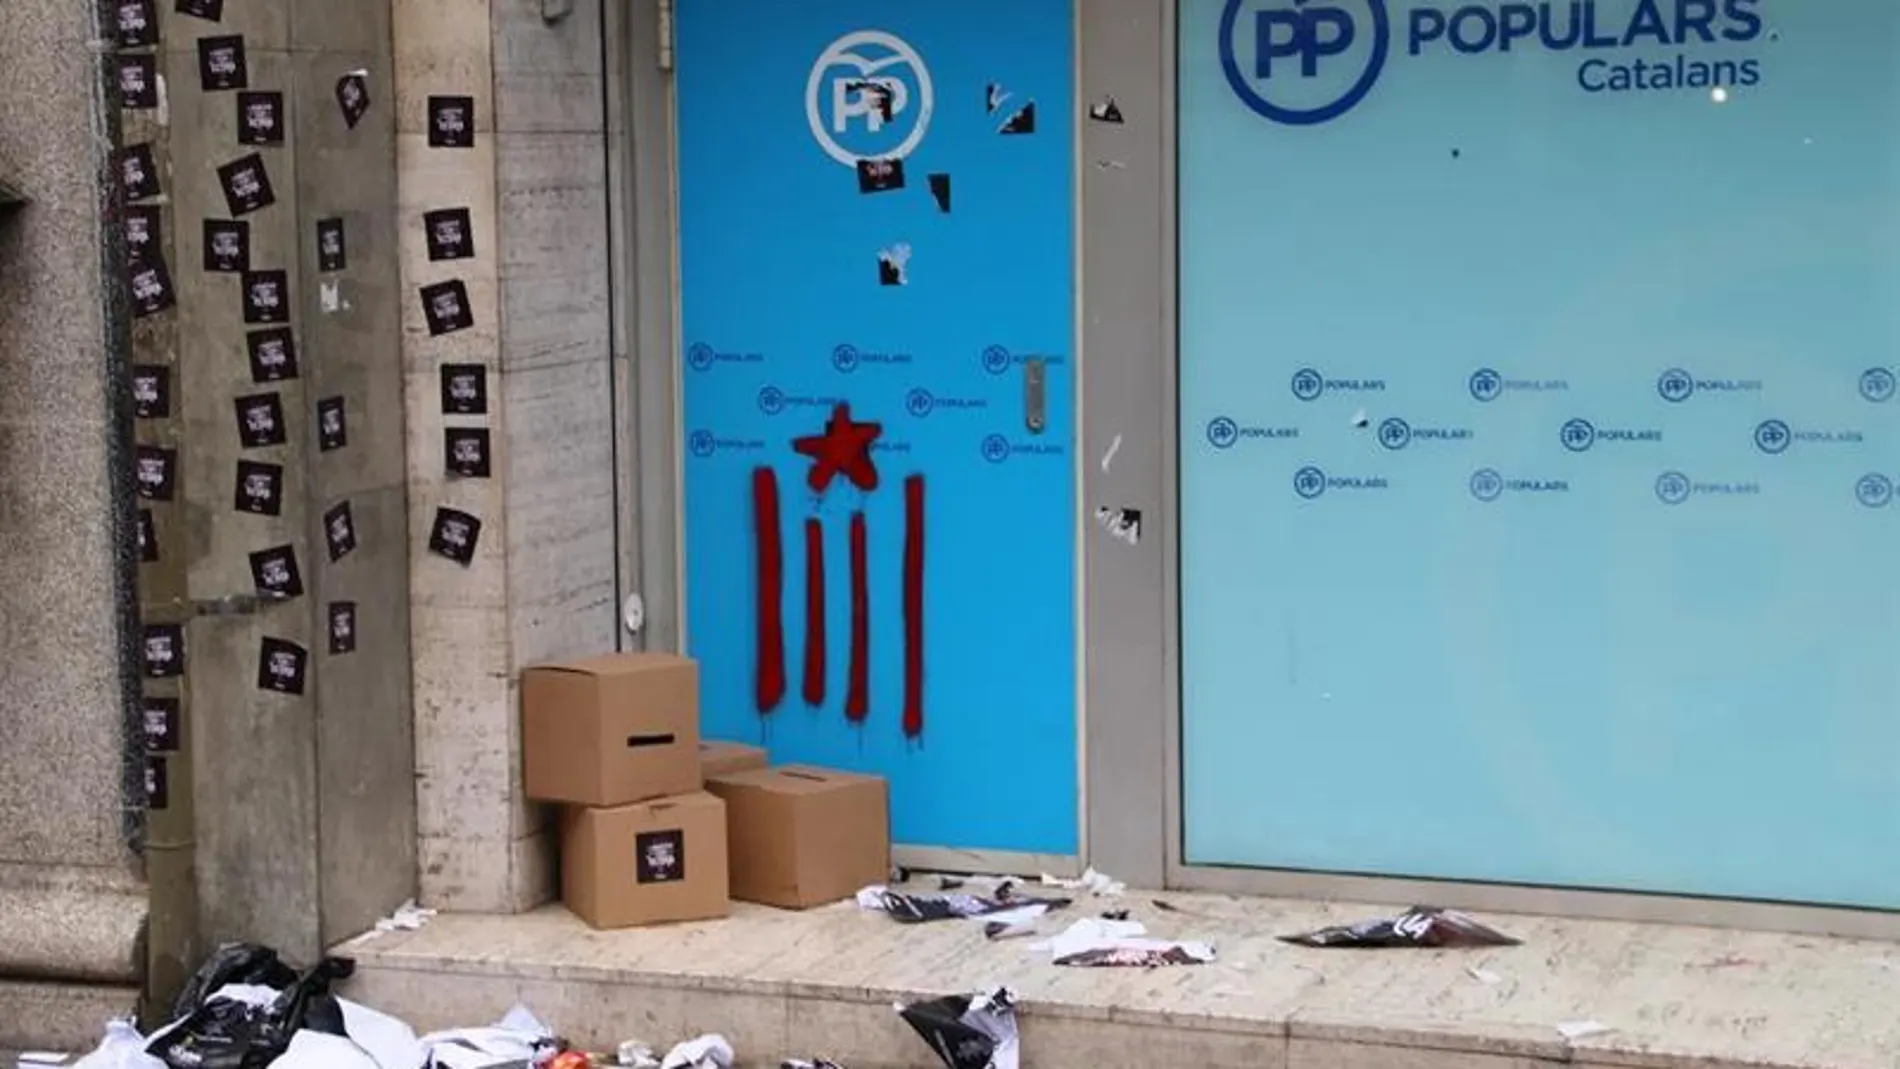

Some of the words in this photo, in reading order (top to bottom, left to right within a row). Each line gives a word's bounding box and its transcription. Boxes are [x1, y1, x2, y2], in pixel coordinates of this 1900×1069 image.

[1255, 6, 1355, 79] PP
[1408, 0, 1762, 55] POPULARS
[1577, 55, 1760, 92] Catalans
